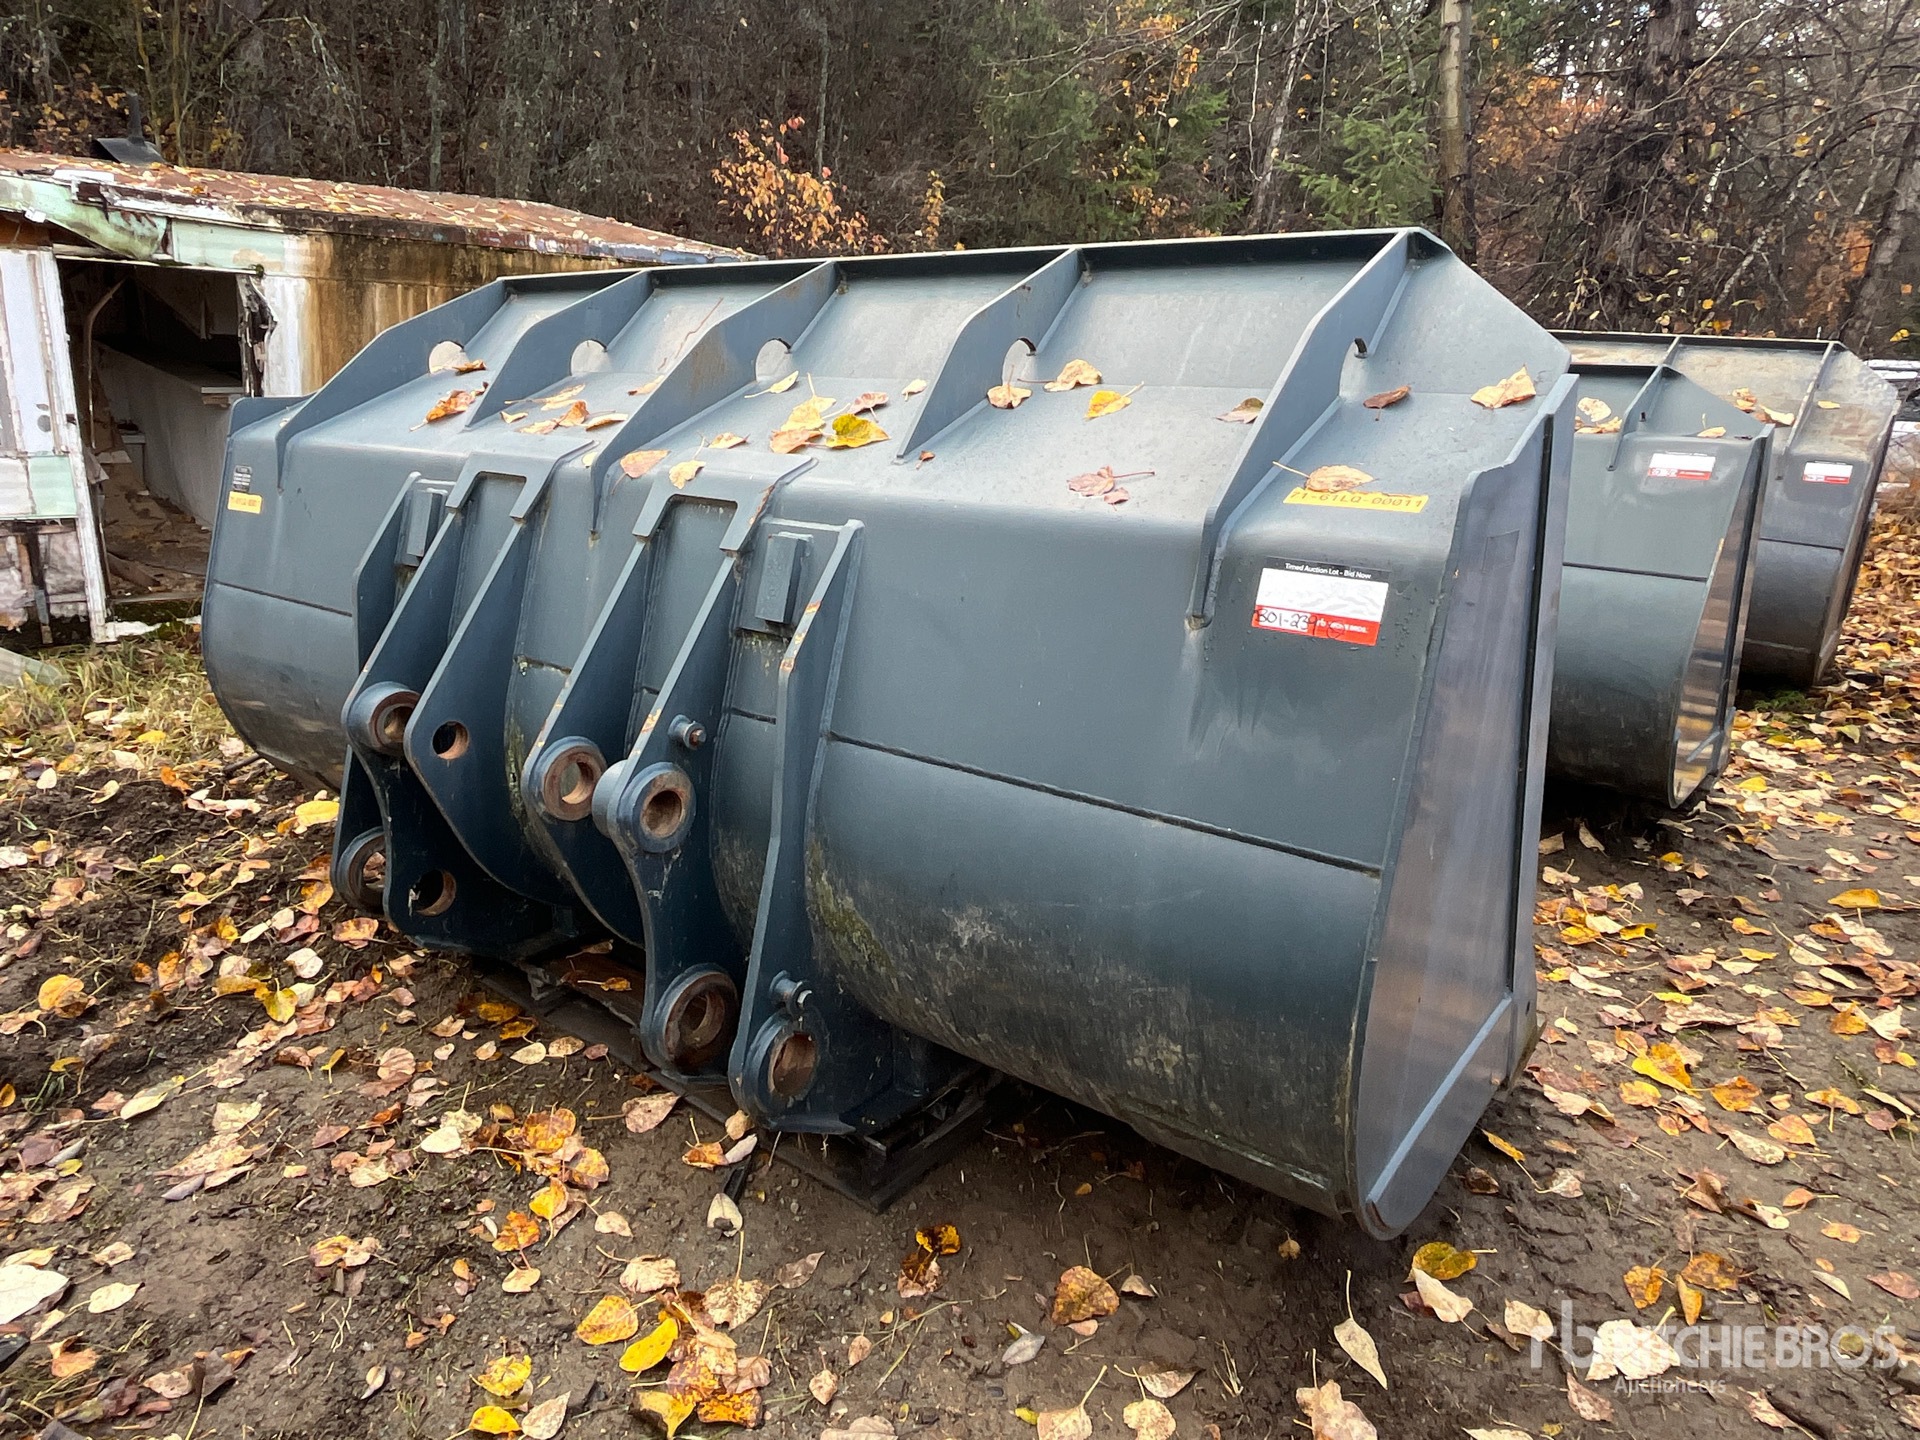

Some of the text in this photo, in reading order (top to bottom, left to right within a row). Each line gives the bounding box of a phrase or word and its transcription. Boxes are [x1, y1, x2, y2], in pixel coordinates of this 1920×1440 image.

[1285, 562, 1304, 571] Timed
[1304, 565, 1328, 574] Auction
[1329, 568, 1339, 576] Lot
